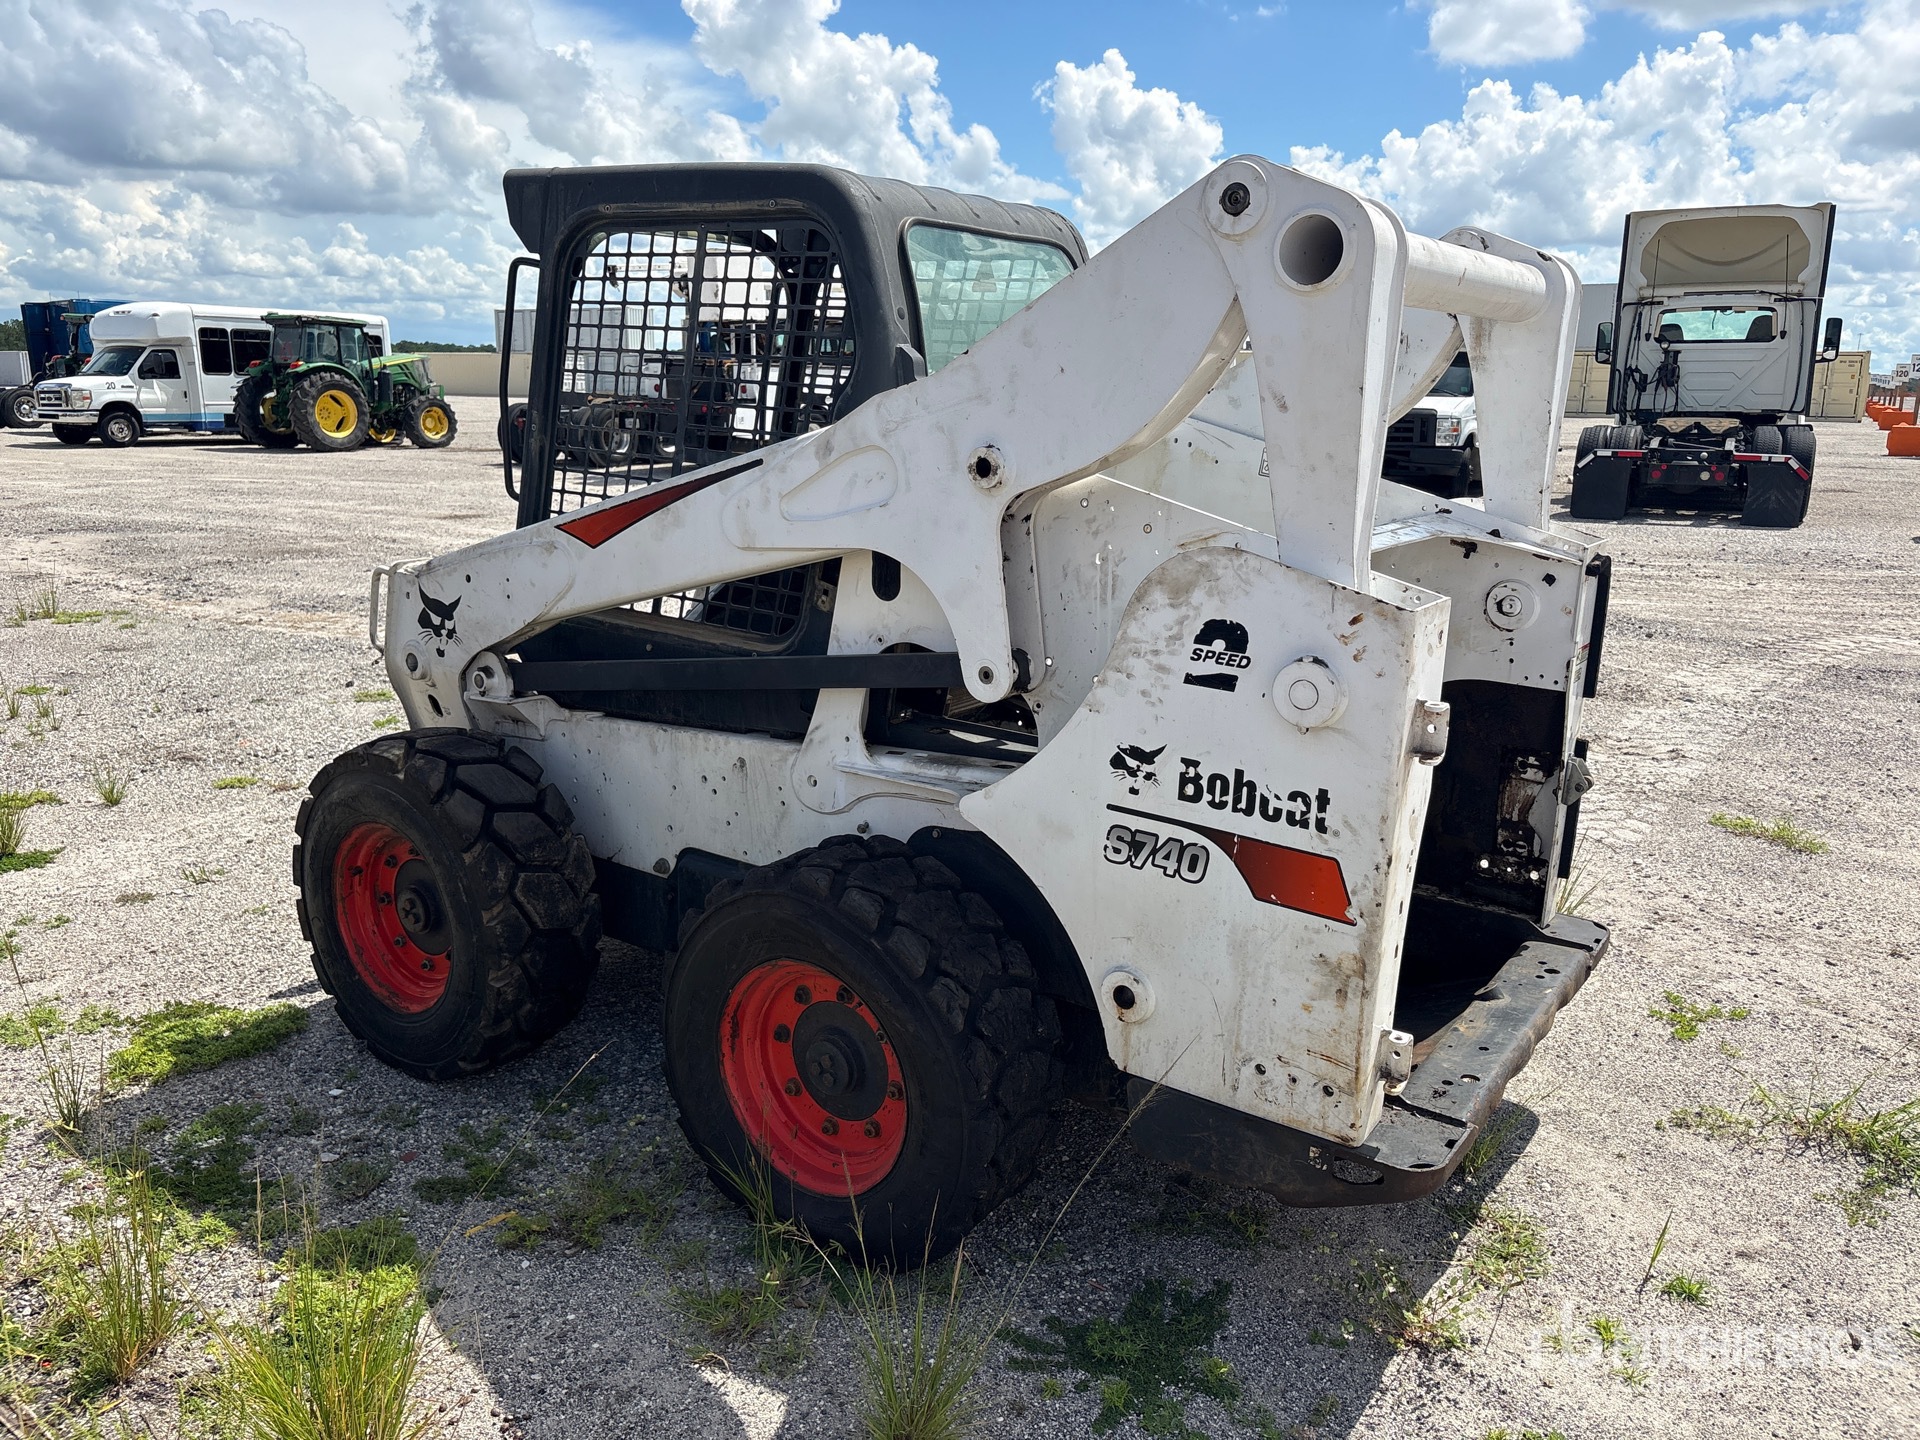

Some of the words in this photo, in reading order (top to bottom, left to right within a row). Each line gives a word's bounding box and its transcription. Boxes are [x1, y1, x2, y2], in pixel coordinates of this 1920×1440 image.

[105, 382, 116, 390] 20
[1190, 648, 1251, 669] SPEED
[1178, 757, 1331, 834] Bobcat
[1104, 825, 1209, 884] S740
